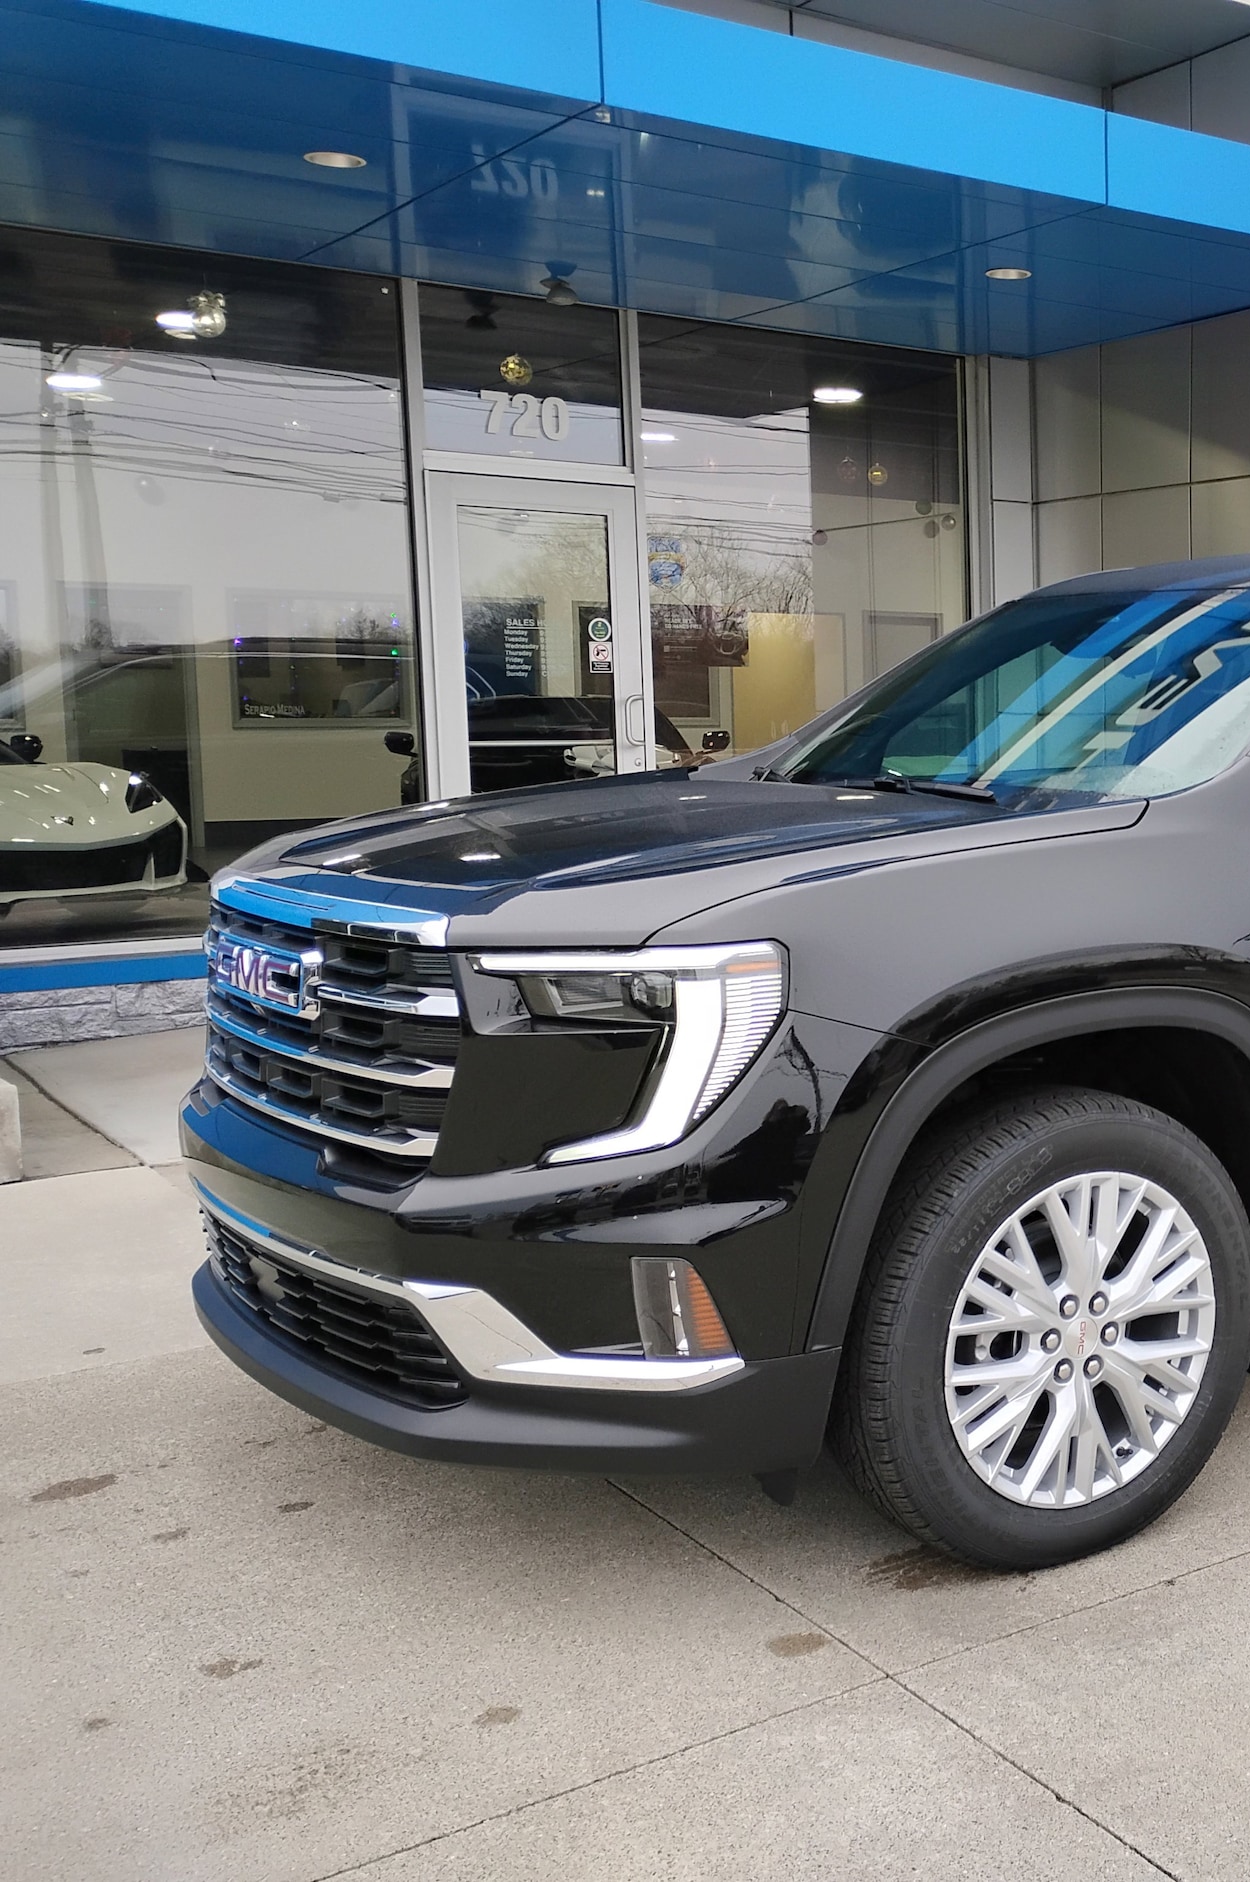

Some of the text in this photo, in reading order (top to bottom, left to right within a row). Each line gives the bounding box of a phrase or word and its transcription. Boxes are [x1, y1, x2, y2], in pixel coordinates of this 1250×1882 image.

[479, 389, 570, 441] 720
[506, 618, 535, 627] SALES
[506, 670, 528, 678] Sunday
[216, 939, 300, 1008] GMC
[1077, 1321, 1087, 1355] GMC
